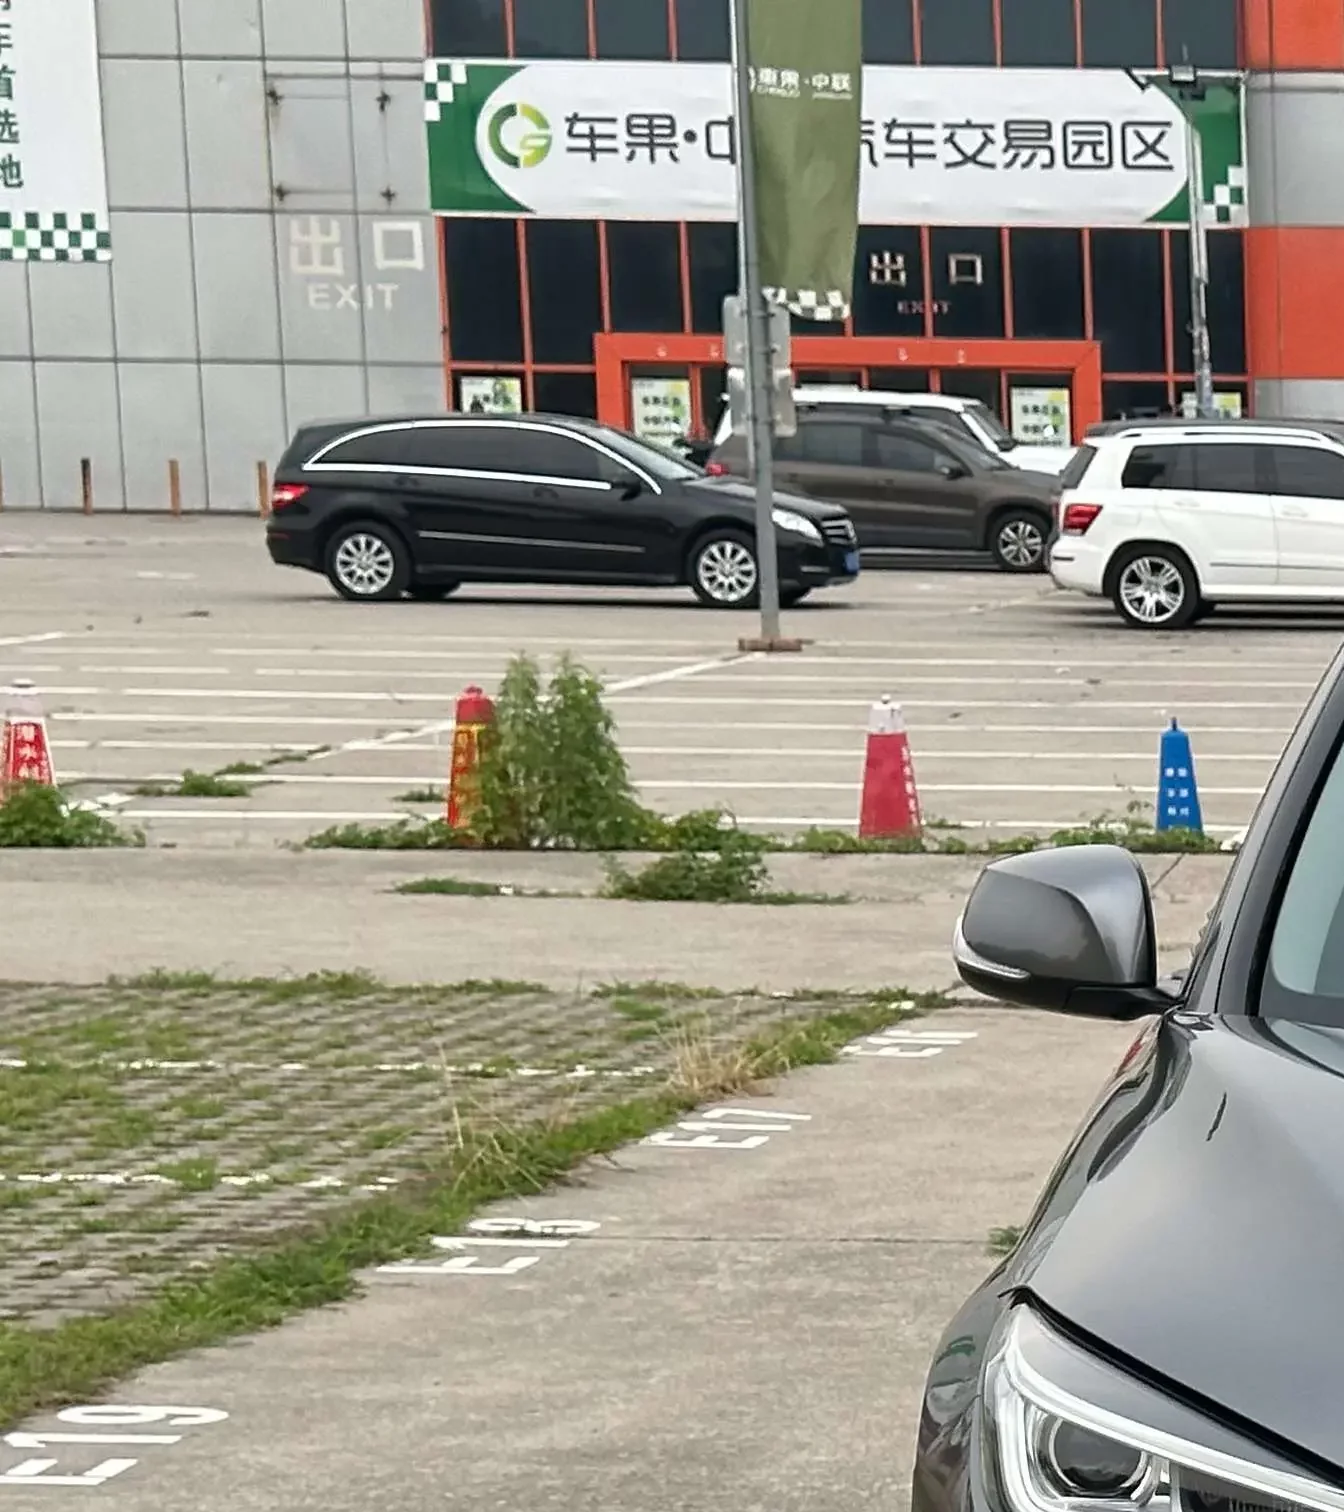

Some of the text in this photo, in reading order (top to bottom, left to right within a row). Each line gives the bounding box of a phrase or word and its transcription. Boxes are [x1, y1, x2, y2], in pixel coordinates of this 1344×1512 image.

[289, 215, 425, 276] 出口
[869, 250, 984, 288] 出口
[307, 282, 399, 311] EXIT
